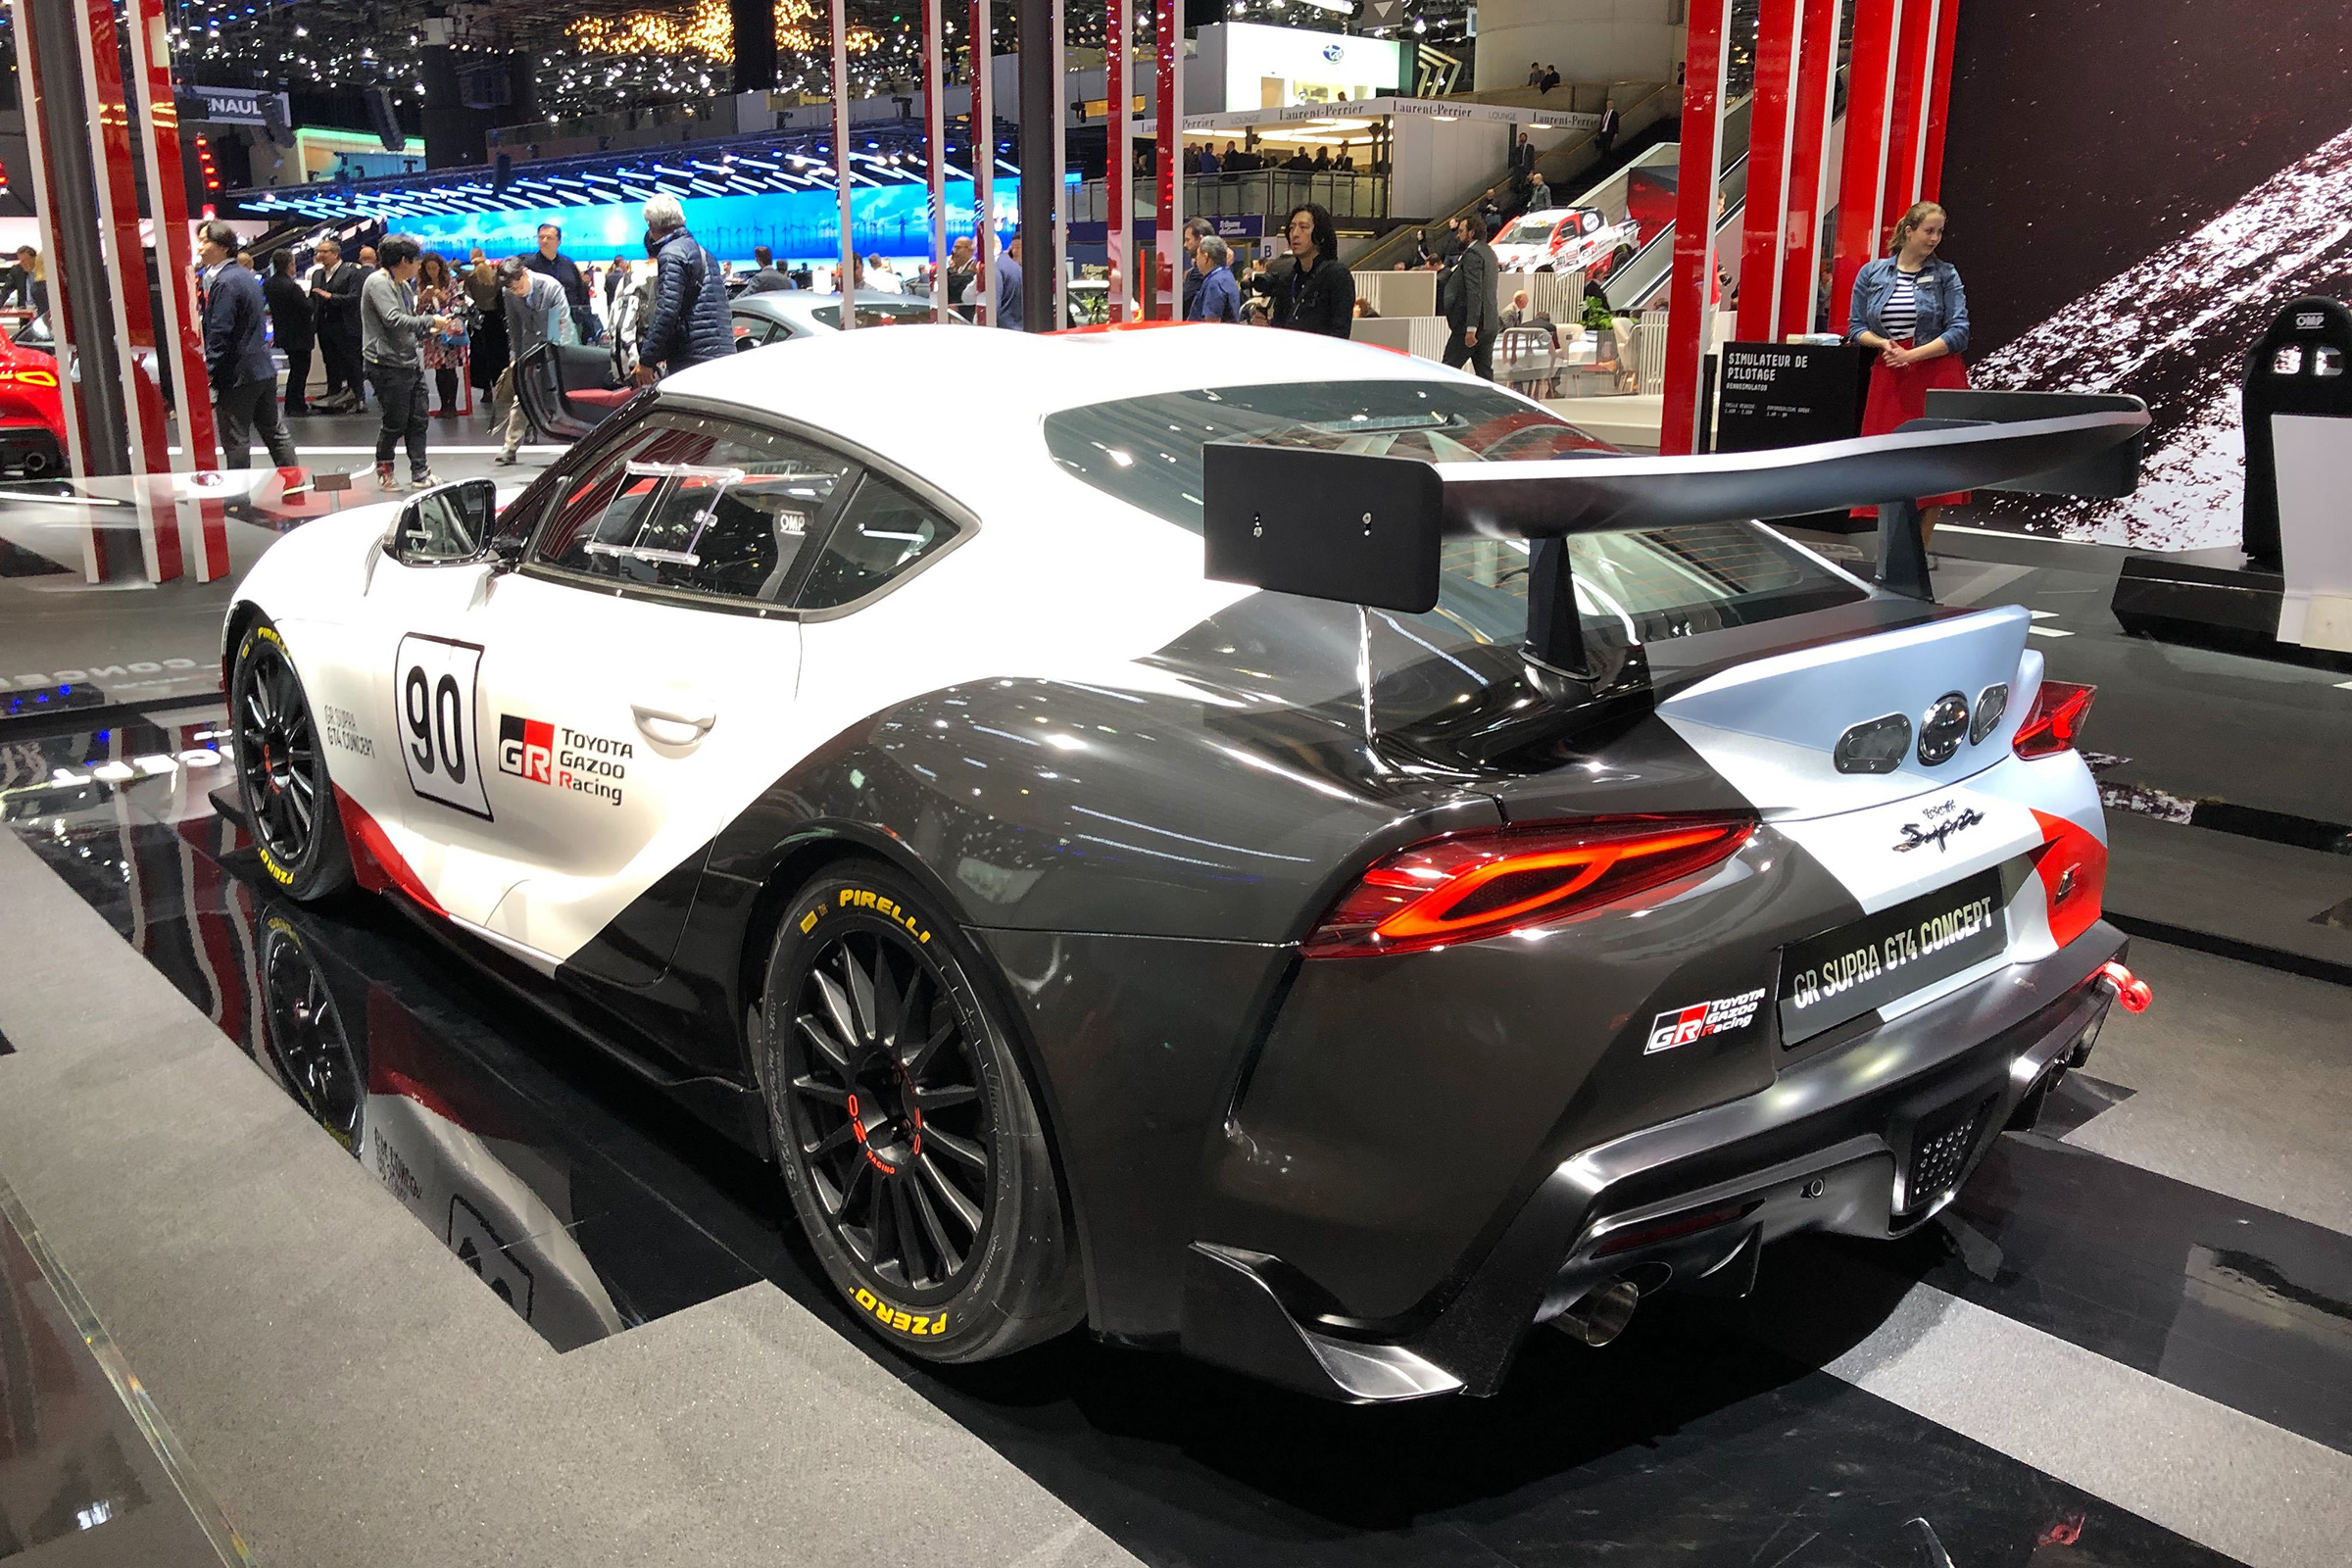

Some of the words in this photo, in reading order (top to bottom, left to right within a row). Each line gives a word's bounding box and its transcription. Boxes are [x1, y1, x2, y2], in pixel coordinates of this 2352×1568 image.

[208, 99, 263, 115] NAUL
[1280, 103, 1364, 121] Laurent-Perrier
[1393, 100, 1472, 118] Laurent-Perrier
[1264, 245, 1272, 258] B
[1728, 353, 1790, 368] SIMULATEUR
[1794, 355, 1809, 368] DE
[1727, 367, 1777, 381] PILOTAGE
[780, 514, 806, 531] OMP
[406, 665, 466, 784] 90
[562, 727, 634, 760] TOYOTA
[500, 738, 552, 784] GR
[560, 750, 625, 779] GAZOO
[559, 770, 623, 807] Racing
[1891, 808, 1986, 854] Supra
[839, 889, 931, 944] PIRELLI
[1793, 968, 1821, 1009] GR
[1822, 944, 1882, 998] SUPRA
[1884, 928, 1918, 971] GT4
[1920, 896, 1993, 956] CONCEPT
[1711, 987, 1767, 1013] TOYOTA
[1700, 1013, 1753, 1037] Racing
[1705, 1002, 1759, 1025] GAZOO
[1648, 1018, 1702, 1051] GR
[864, 1149, 896, 1176] RACING
